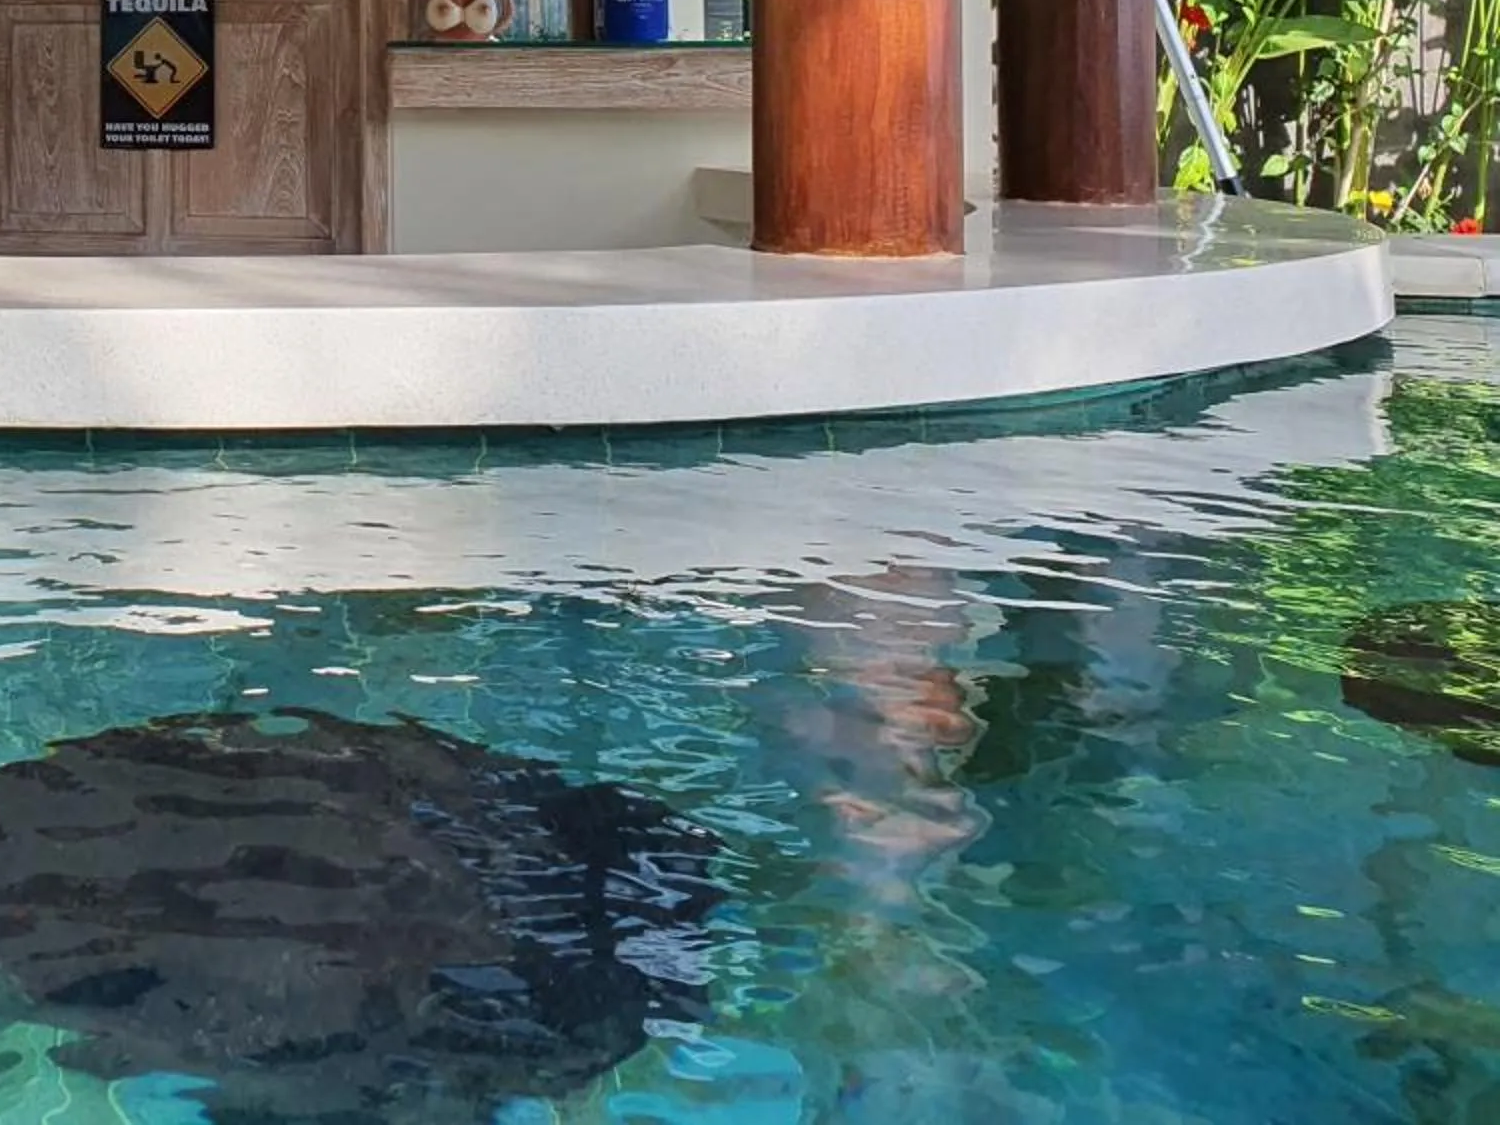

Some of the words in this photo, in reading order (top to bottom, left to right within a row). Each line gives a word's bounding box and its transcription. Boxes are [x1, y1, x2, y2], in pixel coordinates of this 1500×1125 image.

[105, 122, 135, 132] HAVE
[136, 122, 159, 132] YOU
[105, 134, 134, 143] YOUR
[135, 134, 171, 143] TOILET
